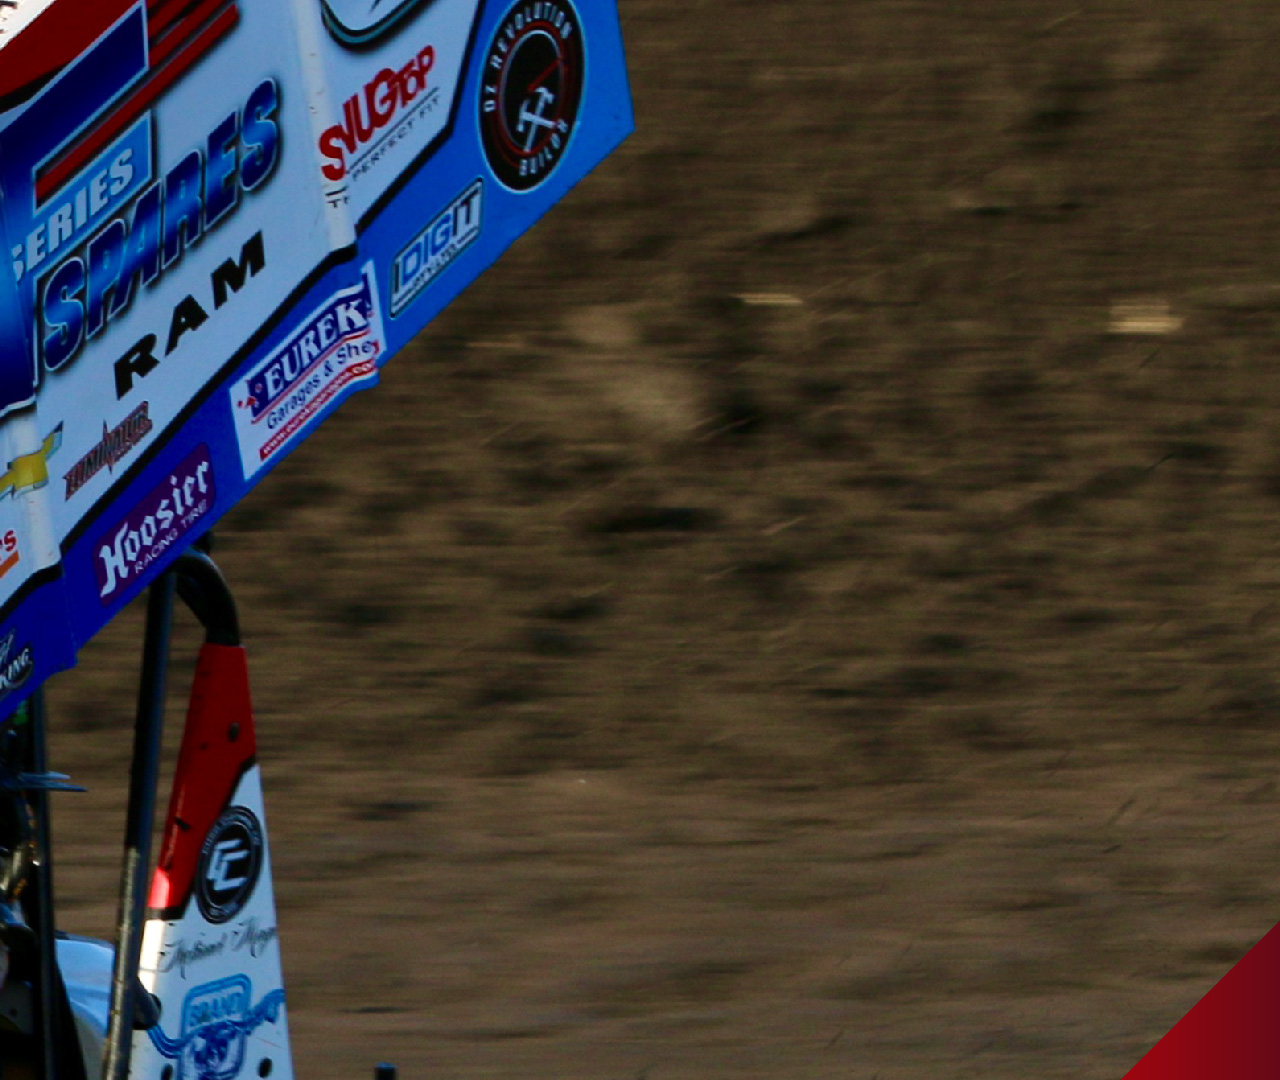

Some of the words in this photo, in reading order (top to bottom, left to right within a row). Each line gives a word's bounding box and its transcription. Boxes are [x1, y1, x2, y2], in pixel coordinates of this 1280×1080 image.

[43, 77, 280, 372] SPARES
[114, 230, 265, 400] RAM
[263, 296, 372, 400] EUREK
[266, 377, 320, 430] Garages
[338, 338, 374, 364] She
[99, 461, 209, 599] Hoosier
[134, 528, 178, 574] RACING
